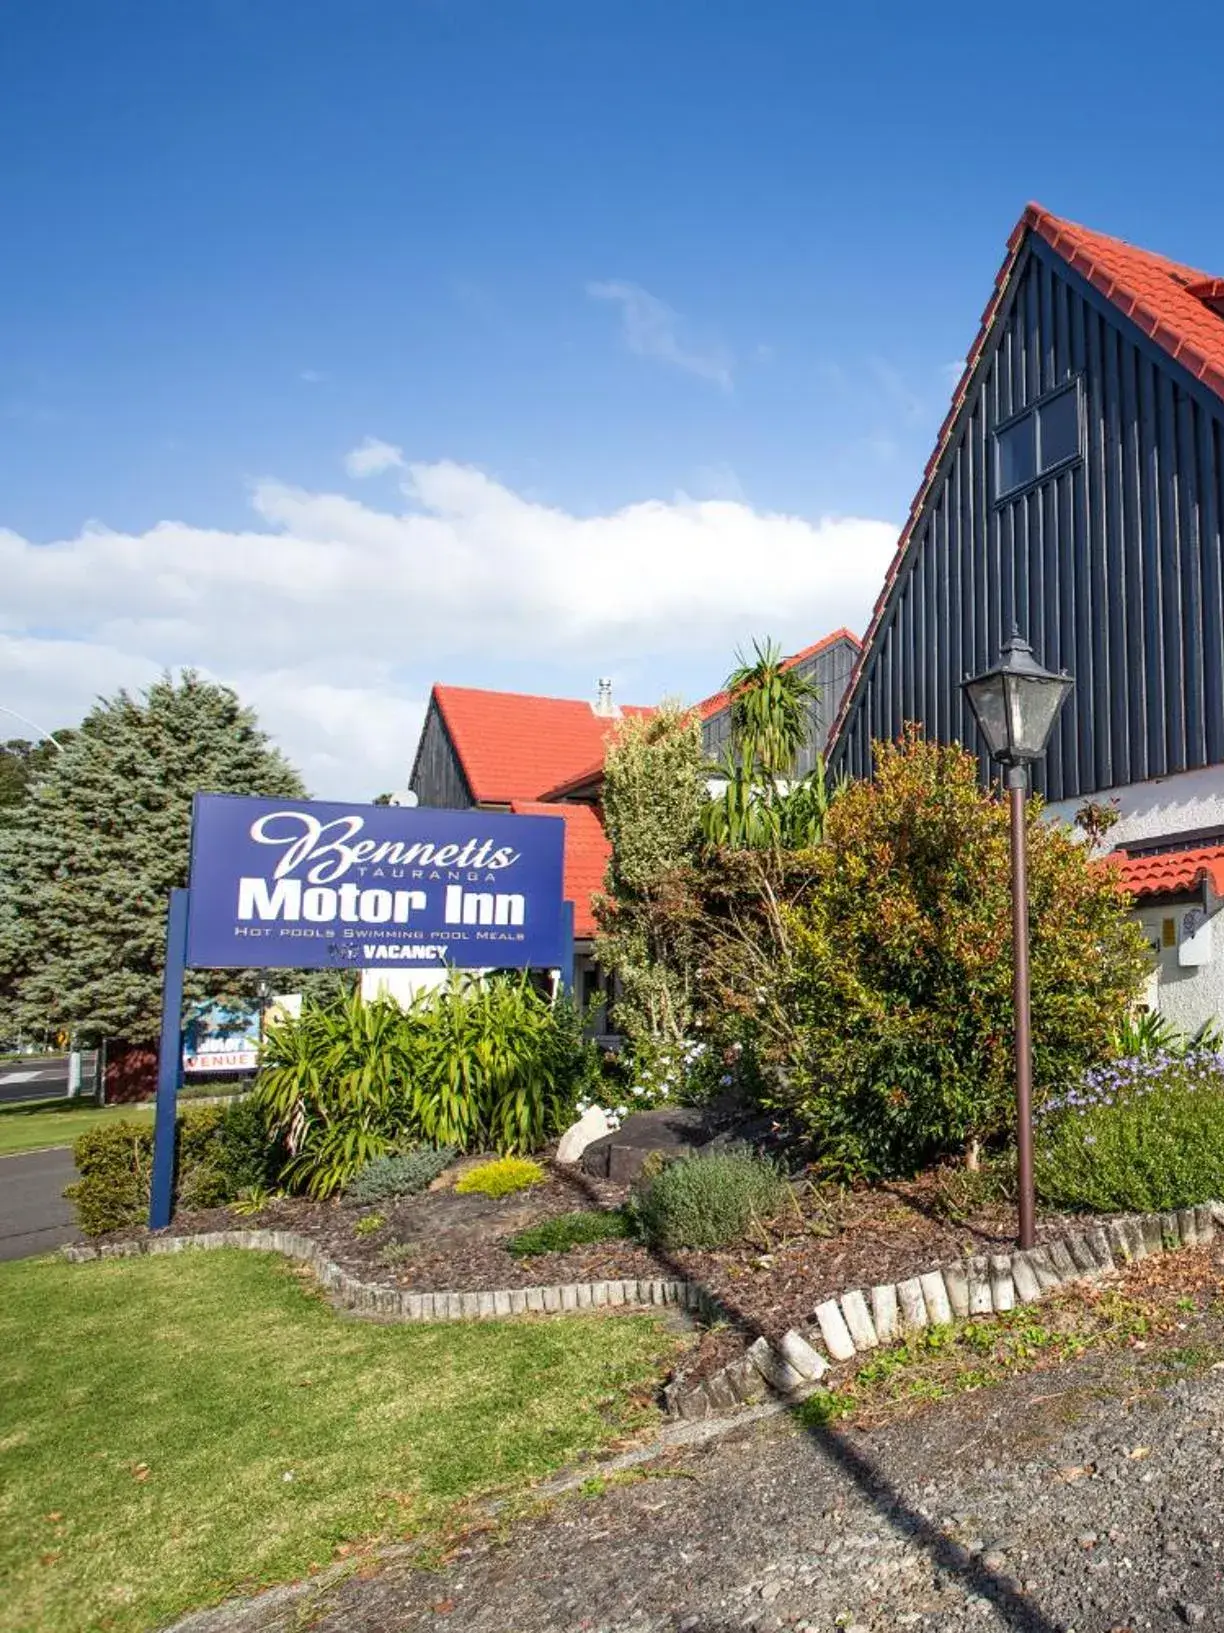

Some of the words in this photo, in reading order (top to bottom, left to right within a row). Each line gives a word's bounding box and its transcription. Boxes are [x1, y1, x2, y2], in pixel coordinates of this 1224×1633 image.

[250, 811, 522, 884] Bennetts
[357, 866, 497, 882] TAURANGA
[237, 877, 426, 924] Motor
[445, 884, 525, 926] Inn
[234, 927, 272, 937] HOT
[343, 928, 424, 939] SWIMMING
[430, 931, 470, 940] POOL
[363, 943, 449, 960] VACANCY
